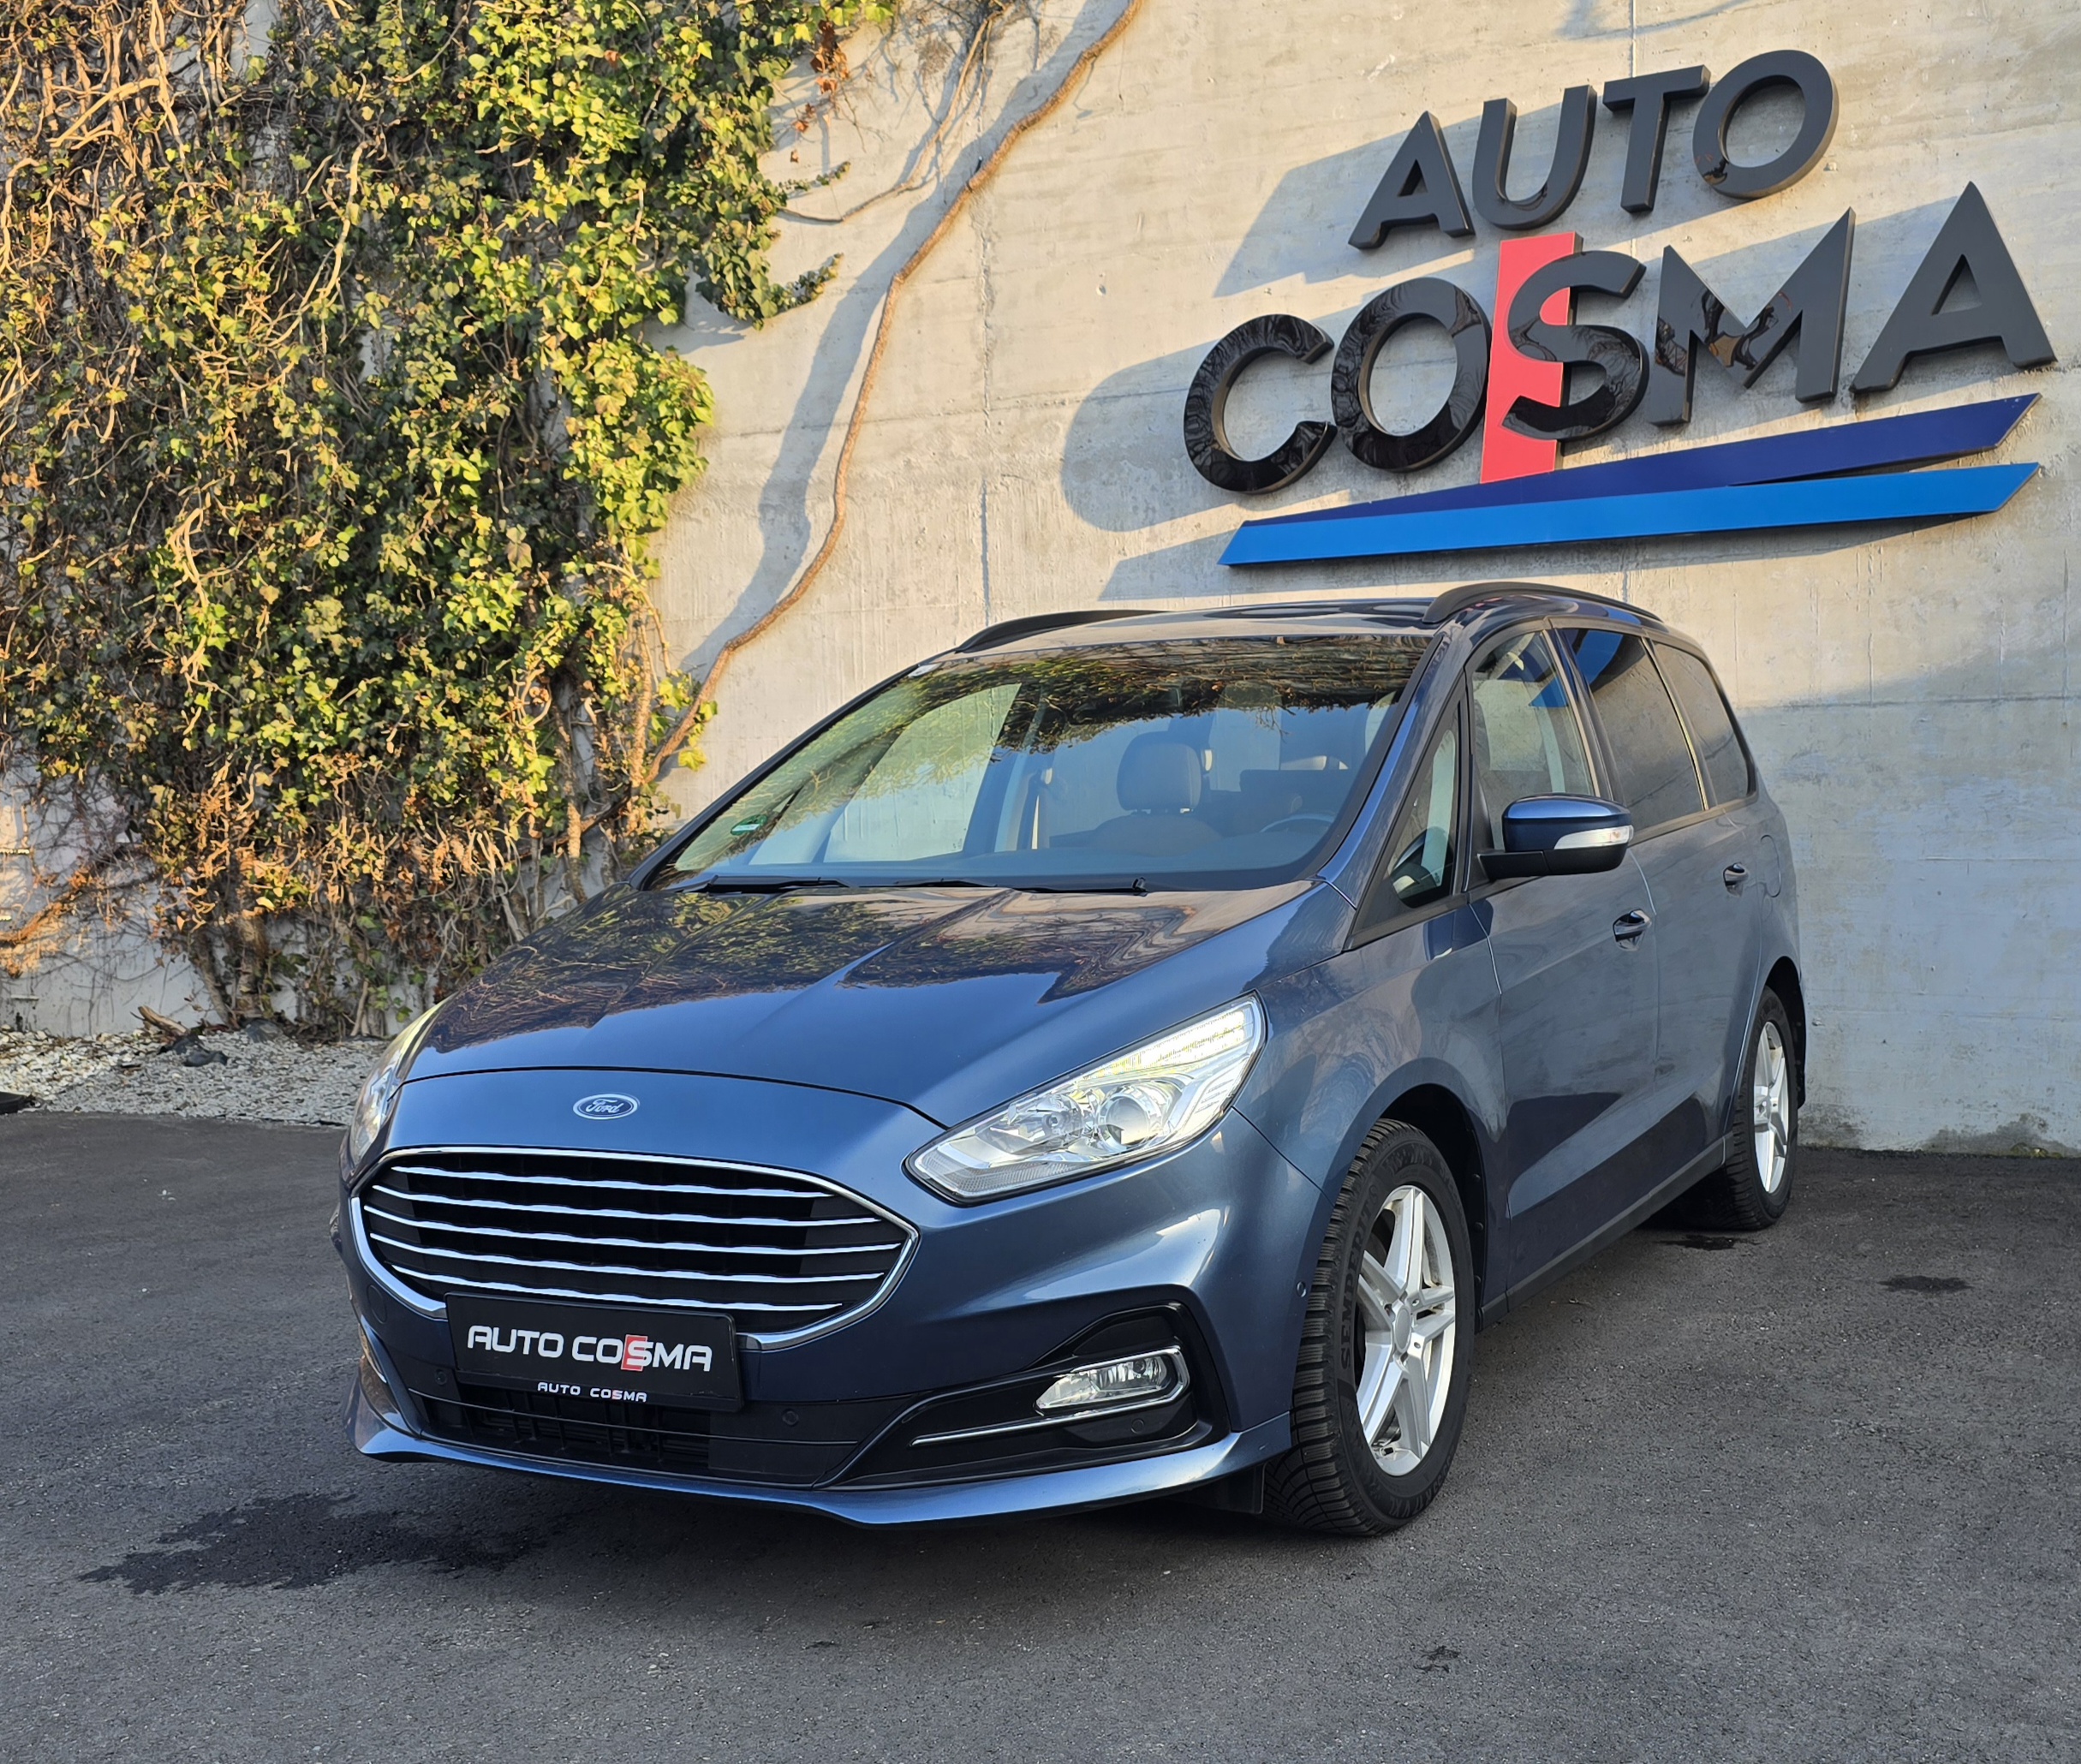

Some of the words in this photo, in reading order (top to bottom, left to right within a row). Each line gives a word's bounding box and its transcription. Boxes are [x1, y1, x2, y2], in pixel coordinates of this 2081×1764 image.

[1348, 50, 1839, 250] AUTO
[1184, 181, 2057, 494] COSMA
[585, 1098, 624, 1113] Ford
[467, 1325, 564, 1358] AUTO
[571, 1336, 713, 1372] COSMA
[537, 1381, 581, 1396] AUTO
[589, 1387, 647, 1403] COSMA
